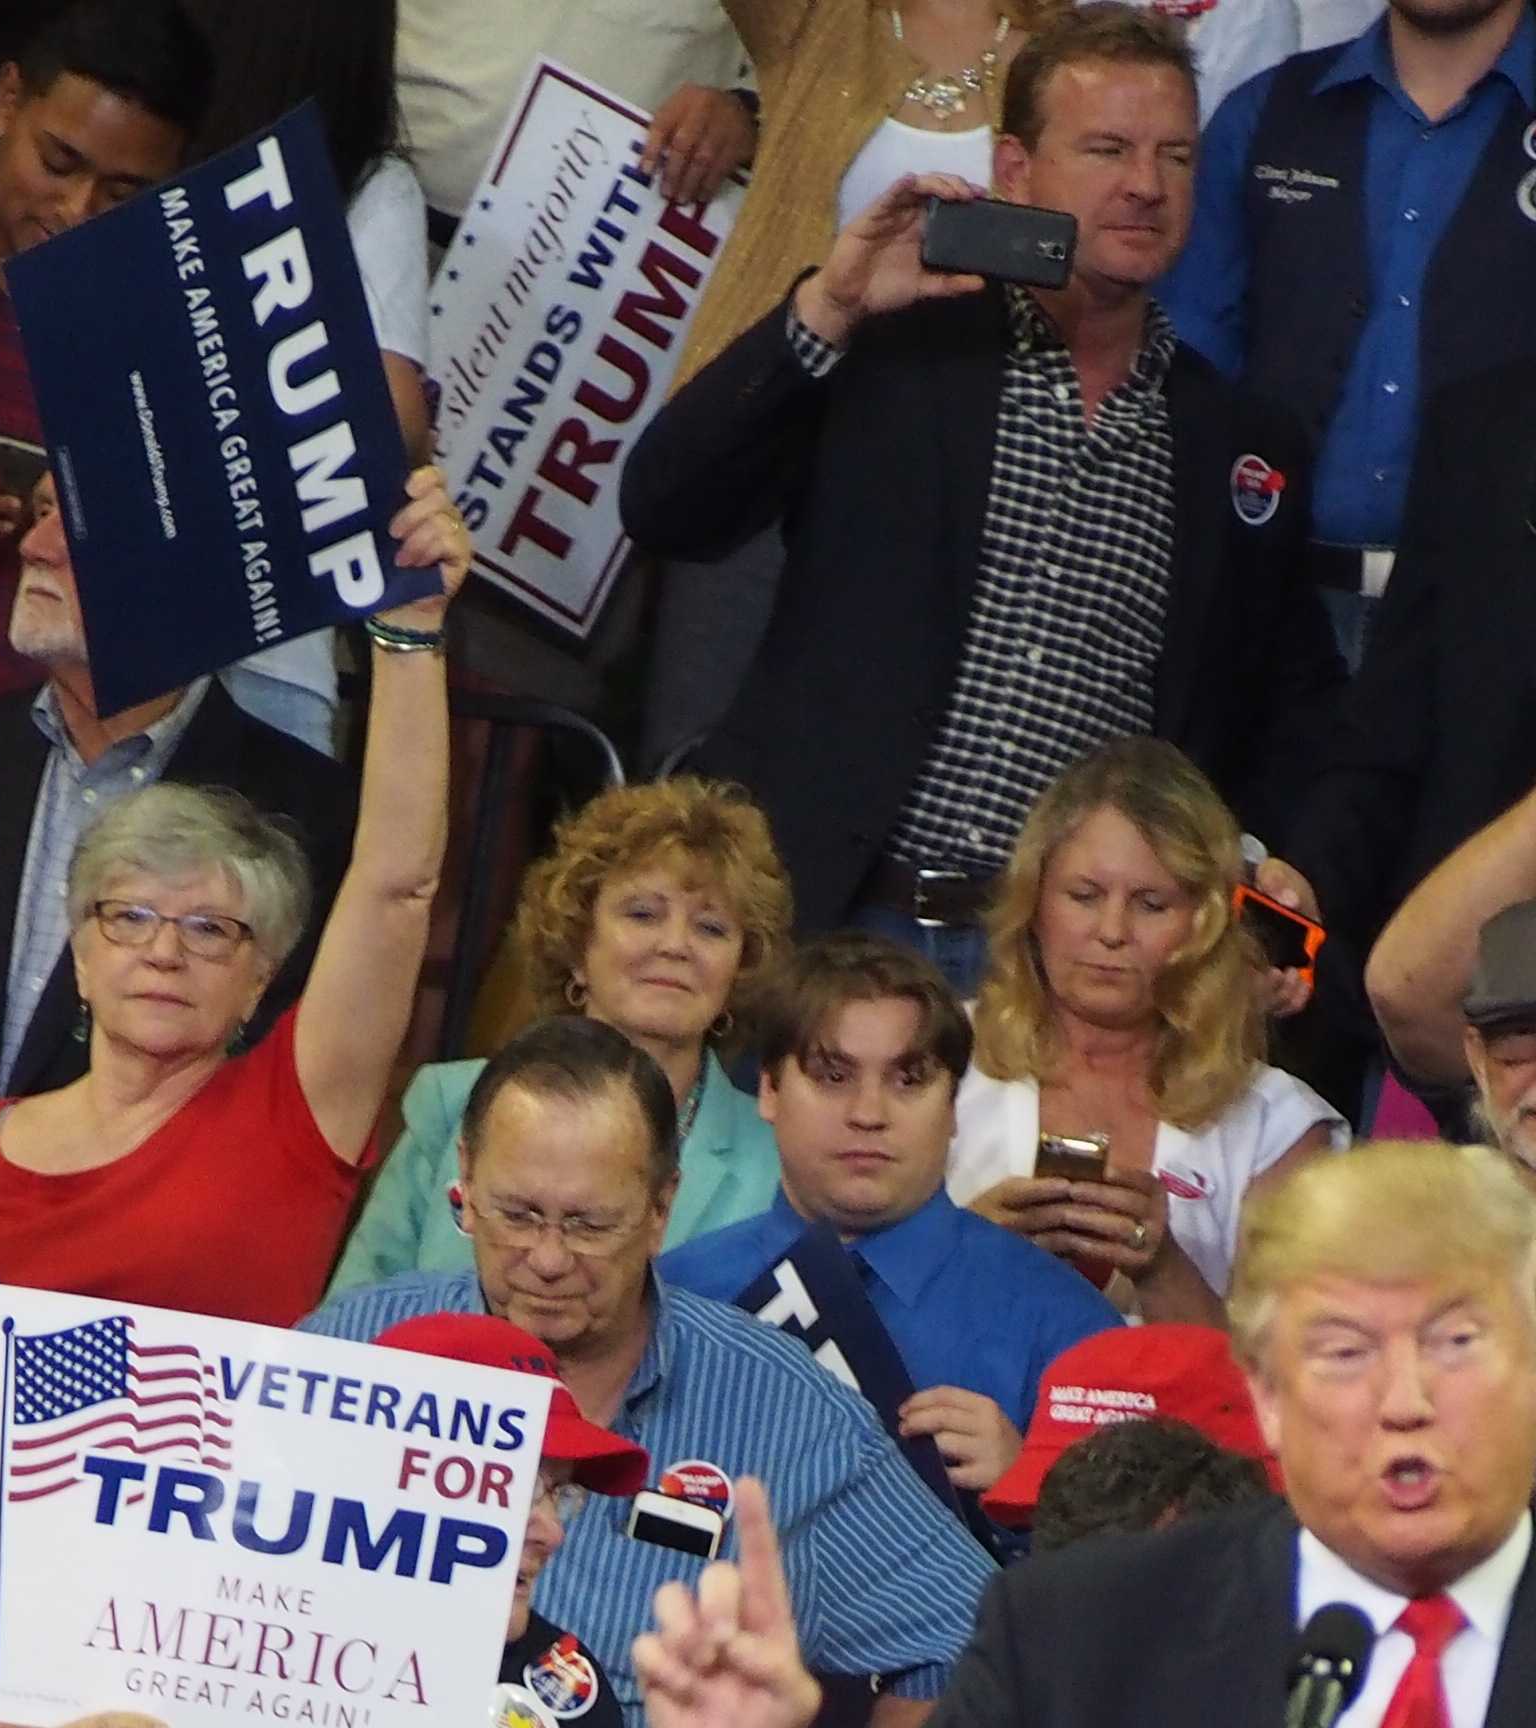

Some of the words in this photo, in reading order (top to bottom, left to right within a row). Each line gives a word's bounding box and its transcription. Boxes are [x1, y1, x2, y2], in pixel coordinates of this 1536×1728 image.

[445, 306, 512, 429] silent
[505, 110, 608, 309] majority
[160, 186, 206, 281] MAKE
[184, 287, 242, 432] AMERICA
[220, 434, 264, 534] GREAT
[242, 538, 284, 643] AGAIN!
[224, 135, 386, 608] TRUMP
[455, 303, 583, 532] STANDS
[498, 197, 720, 561] TRUMP
[219, 1356, 527, 1452] VETERANS
[1086, 1388, 1157, 1411] AMERICA
[83, 1455, 509, 1586] TRUMP
[397, 1448, 515, 1508] FOR
[83, 1595, 430, 1707] AMERICA
[217, 1575, 317, 1616] MAKE
[125, 1667, 240, 1708] GREAT
